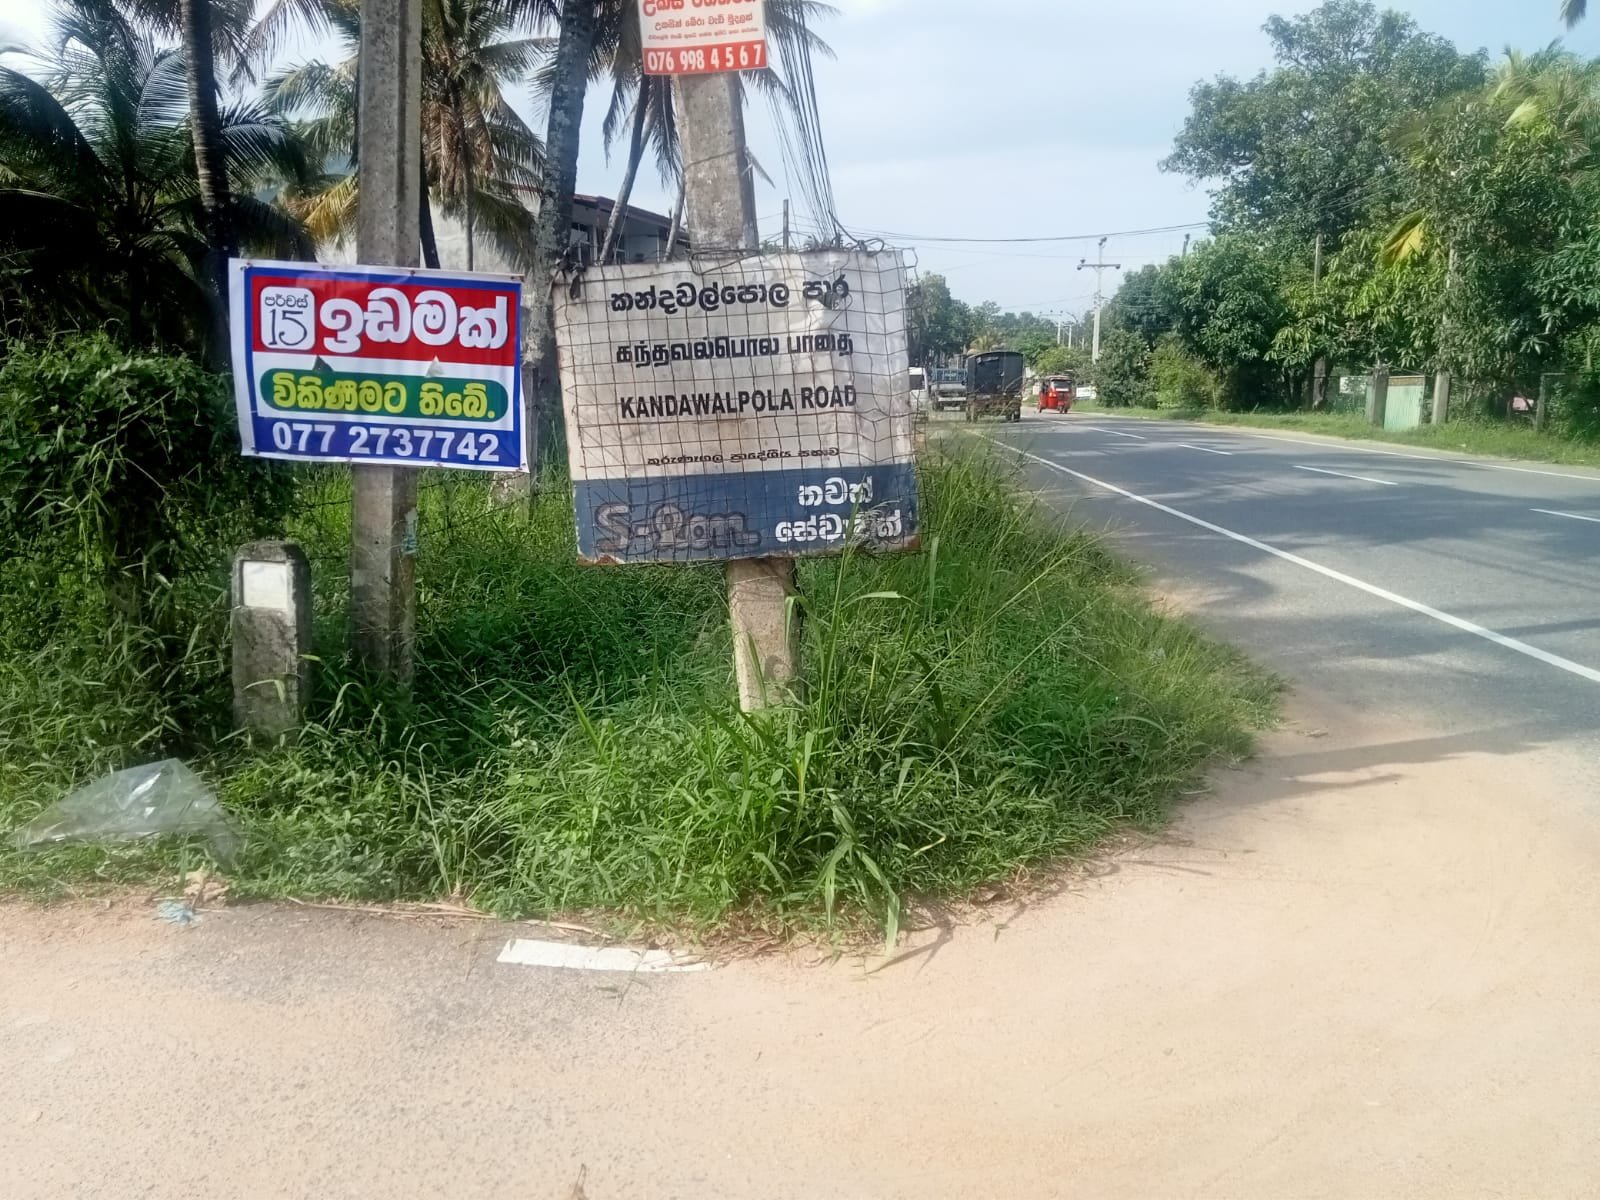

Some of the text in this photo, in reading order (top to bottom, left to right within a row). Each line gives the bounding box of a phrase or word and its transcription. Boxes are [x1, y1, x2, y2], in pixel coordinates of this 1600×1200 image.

[648, 51, 674, 71] 076
[680, 49, 705, 71] 998
[264, 293, 309, 308] පර්චස්
[610, 274, 849, 315] කන්දවල්පොල පාර
[268, 309, 308, 346] 15
[320, 288, 508, 353] ඉඩමක්
[616, 335, 780, 368] கந்தவல்பொல
[272, 372, 496, 420] විකිණීමට තිබේ.
[620, 384, 857, 419] KANDAWALPOLA ROAD
[272, 421, 500, 462] 077 2737742
